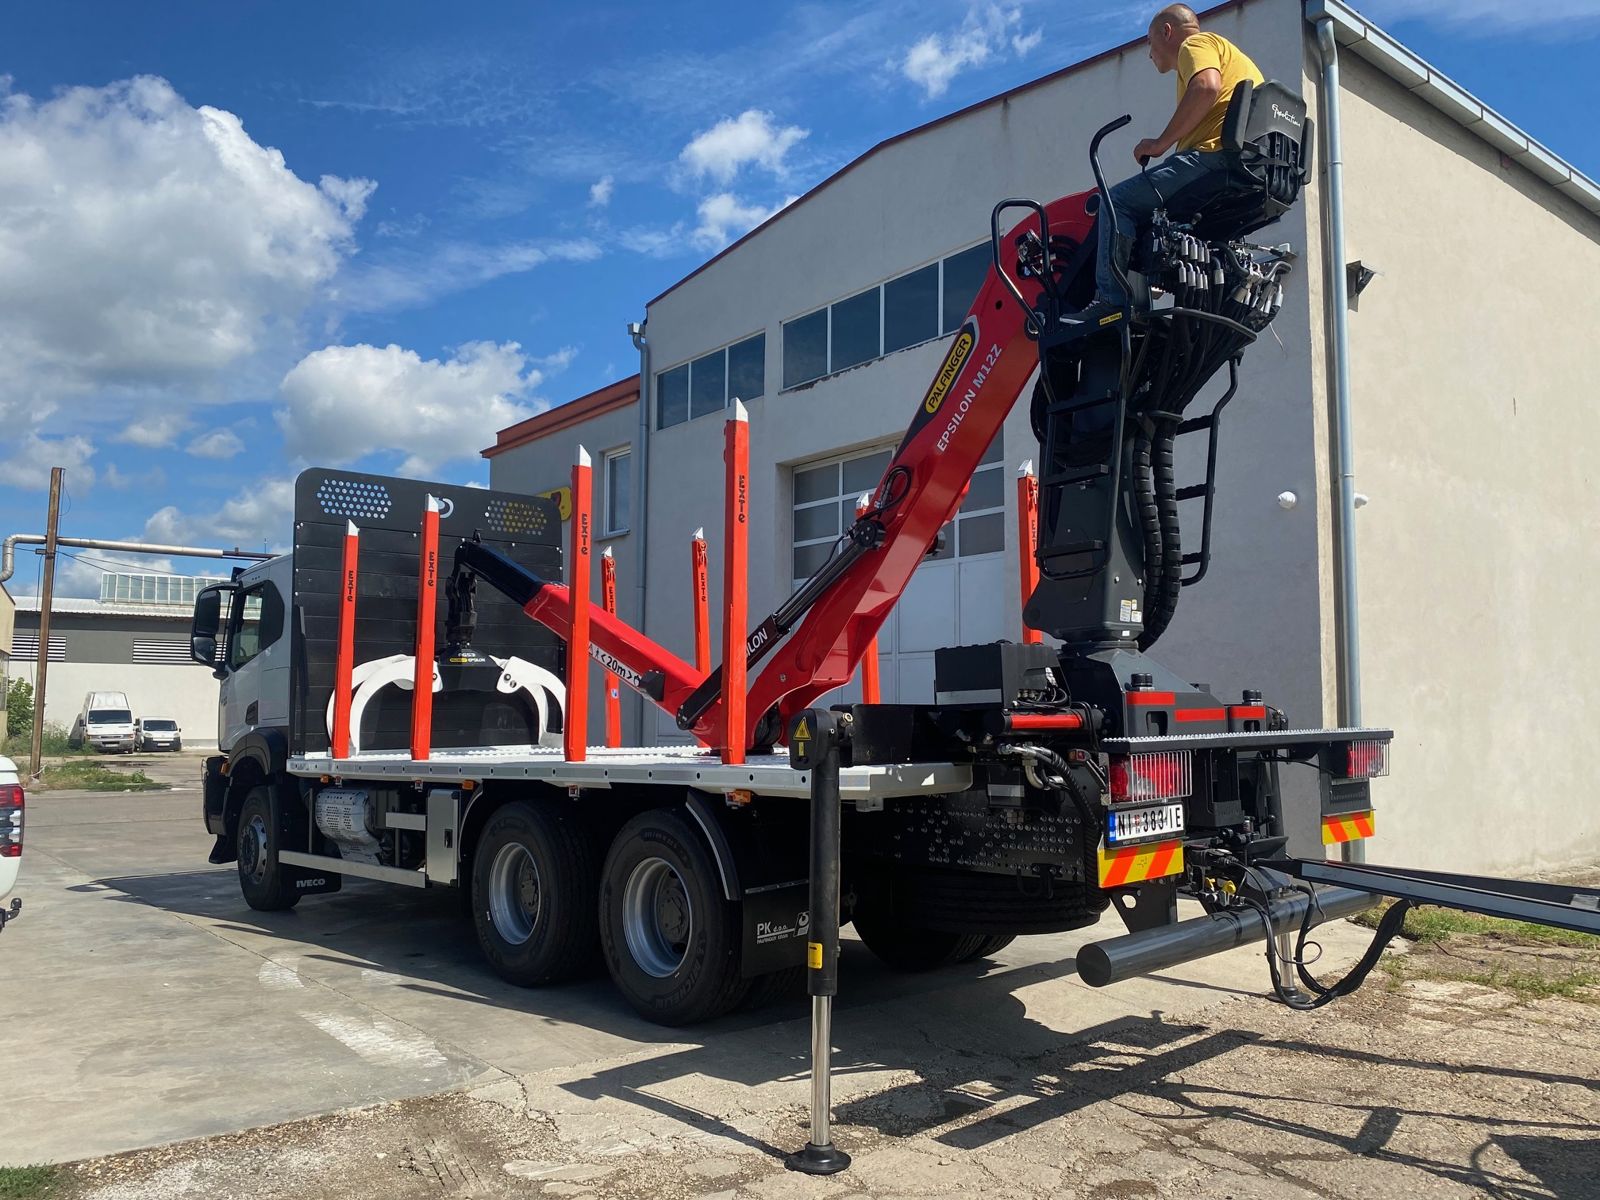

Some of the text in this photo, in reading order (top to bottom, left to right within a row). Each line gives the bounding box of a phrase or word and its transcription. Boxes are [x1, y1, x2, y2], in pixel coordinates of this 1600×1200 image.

[927, 337, 970, 409] PALFINGER
[937, 343, 1002, 452] EPSILON M12Z
[746, 627, 768, 657] ILON
[1118, 813, 1132, 837] NI
[296, 878, 326, 888] IVECO
[756, 921, 771, 936] PK
